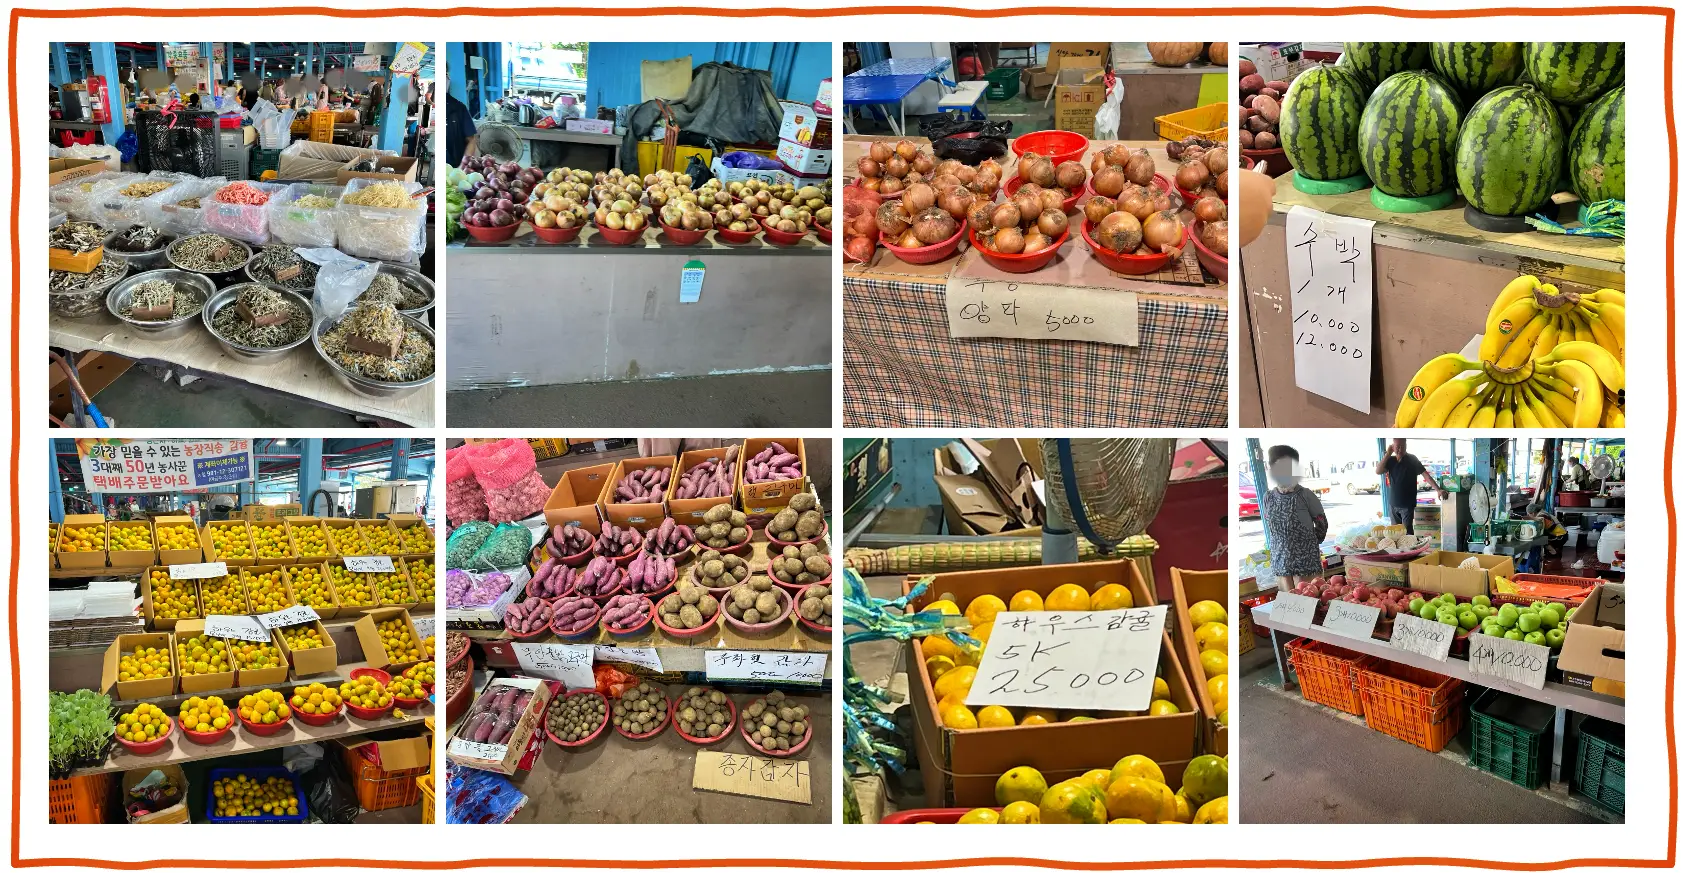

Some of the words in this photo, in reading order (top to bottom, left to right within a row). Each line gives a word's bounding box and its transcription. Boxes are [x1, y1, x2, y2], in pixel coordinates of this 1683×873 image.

[94, 445, 117, 459] 가장
[120, 445, 143, 458] 믿을
[146, 446, 158, 457] 수
[160, 445, 181, 457] 있는
[183, 443, 224, 456] 농장직송
[92, 459, 124, 473] 3대째
[125, 459, 156, 473] 50년
[157, 460, 188, 473] 농사꾼
